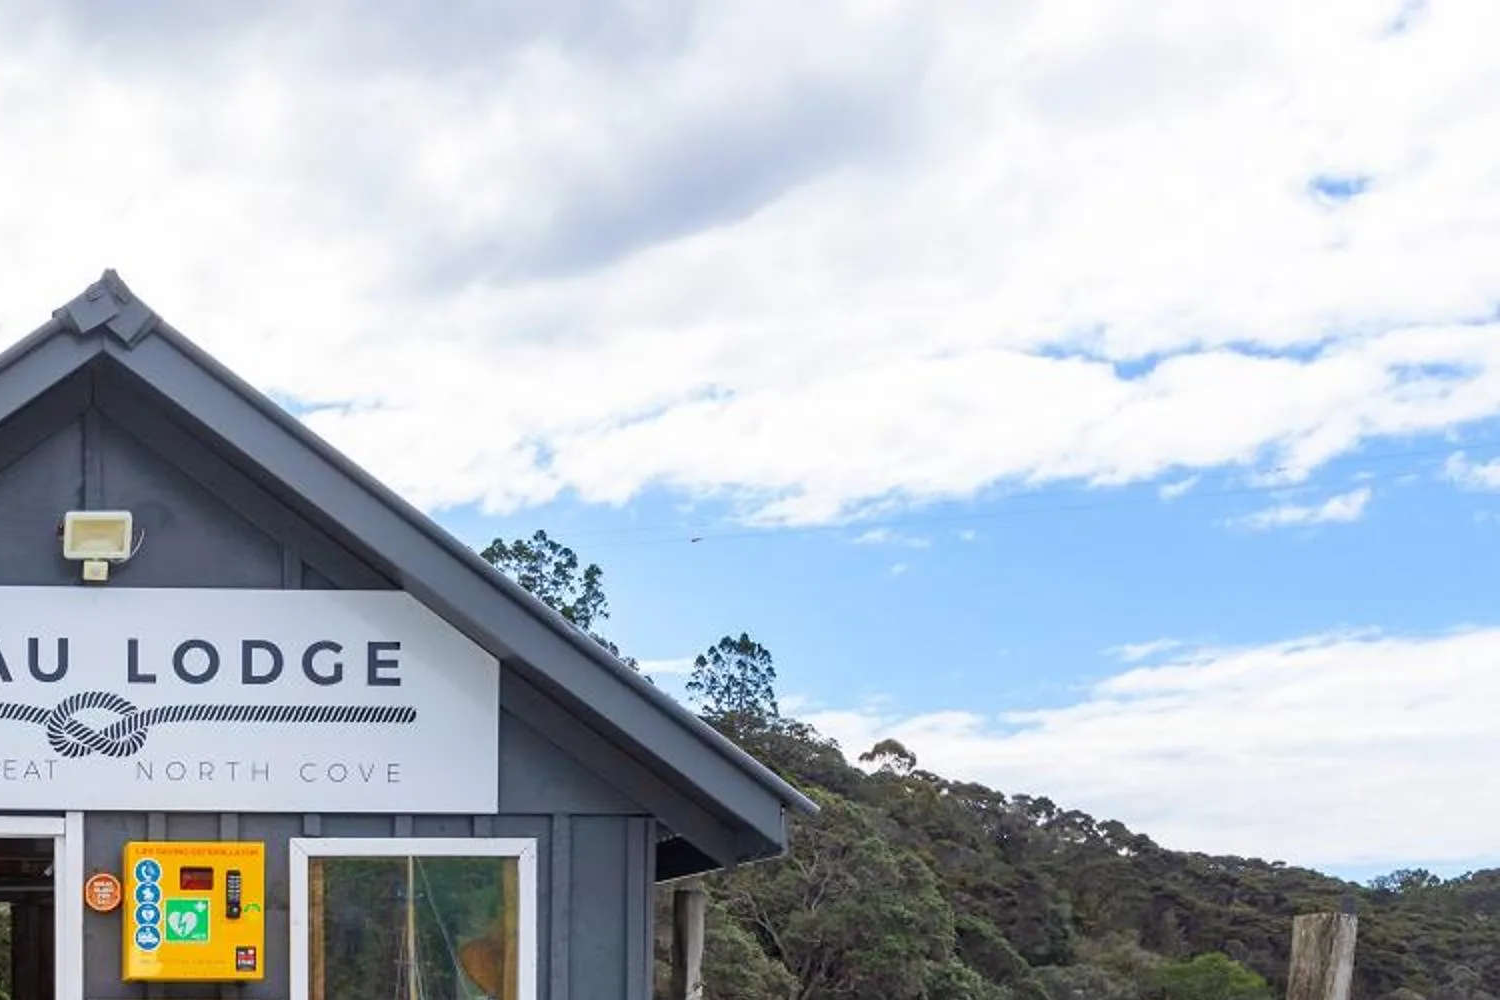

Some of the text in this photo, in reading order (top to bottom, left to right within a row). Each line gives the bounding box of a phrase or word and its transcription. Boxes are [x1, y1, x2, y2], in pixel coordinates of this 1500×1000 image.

[128, 638, 402, 687] LODGE
[137, 761, 402, 784] NORTH COVE
